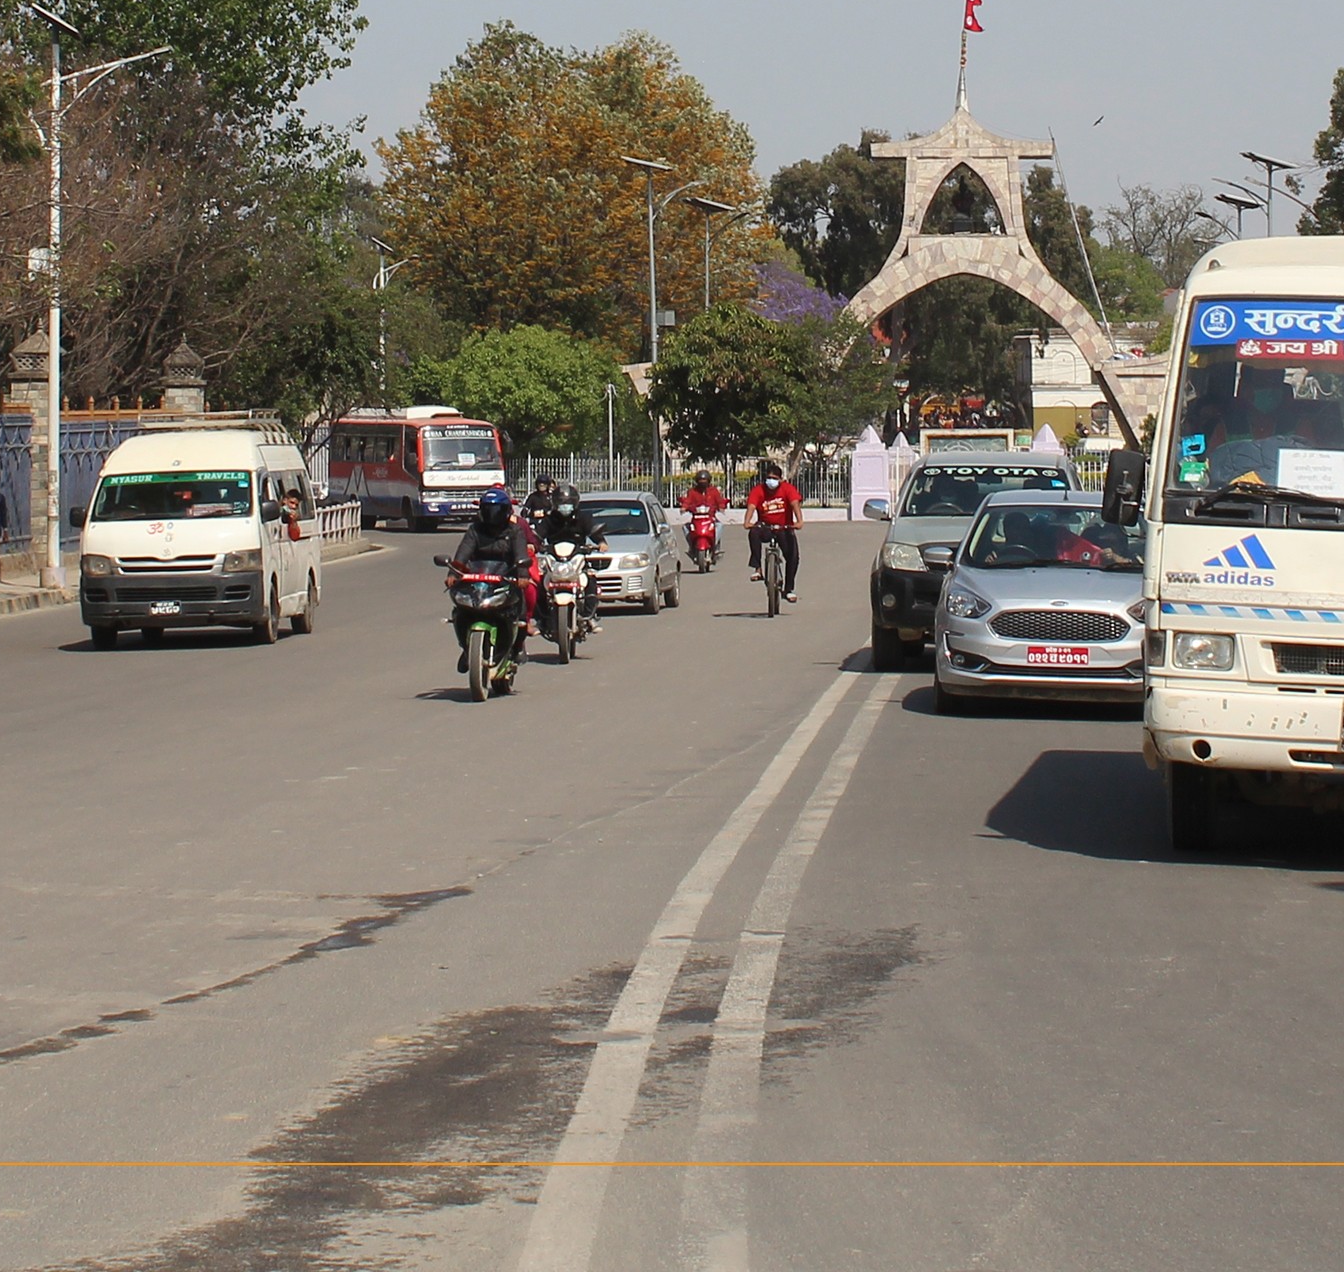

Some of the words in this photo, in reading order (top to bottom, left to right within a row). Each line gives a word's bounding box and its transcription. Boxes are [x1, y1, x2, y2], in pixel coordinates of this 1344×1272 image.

[1266, 341, 1307, 355] जय
[1311, 341, 1338, 356] श्री
[196, 472, 246, 480] TRAVELS
[943, 467, 989, 475] TOY
[993, 468, 1039, 476] OTA
[1166, 572, 1200, 583] TATA
[1204, 571, 1274, 586] adidas
